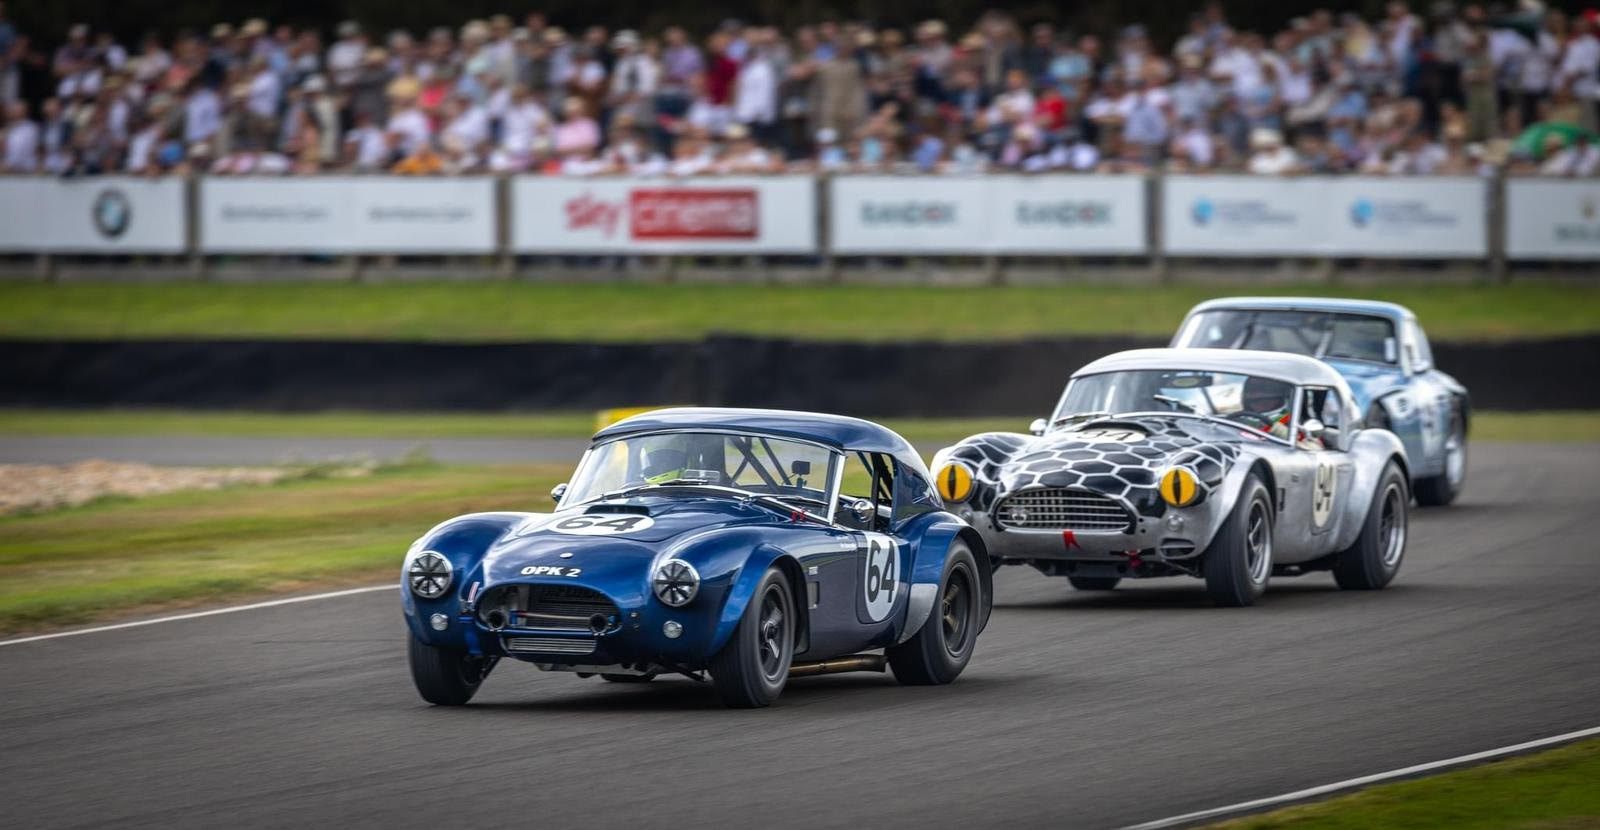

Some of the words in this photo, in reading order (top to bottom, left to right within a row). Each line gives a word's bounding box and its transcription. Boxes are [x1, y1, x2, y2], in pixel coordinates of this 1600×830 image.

[565, 190, 623, 238] sky
[1315, 462, 1333, 511] 94
[557, 515, 646, 531] 64
[521, 566, 564, 576] OPK
[569, 568, 582, 578] 2
[867, 540, 895, 603] 64
